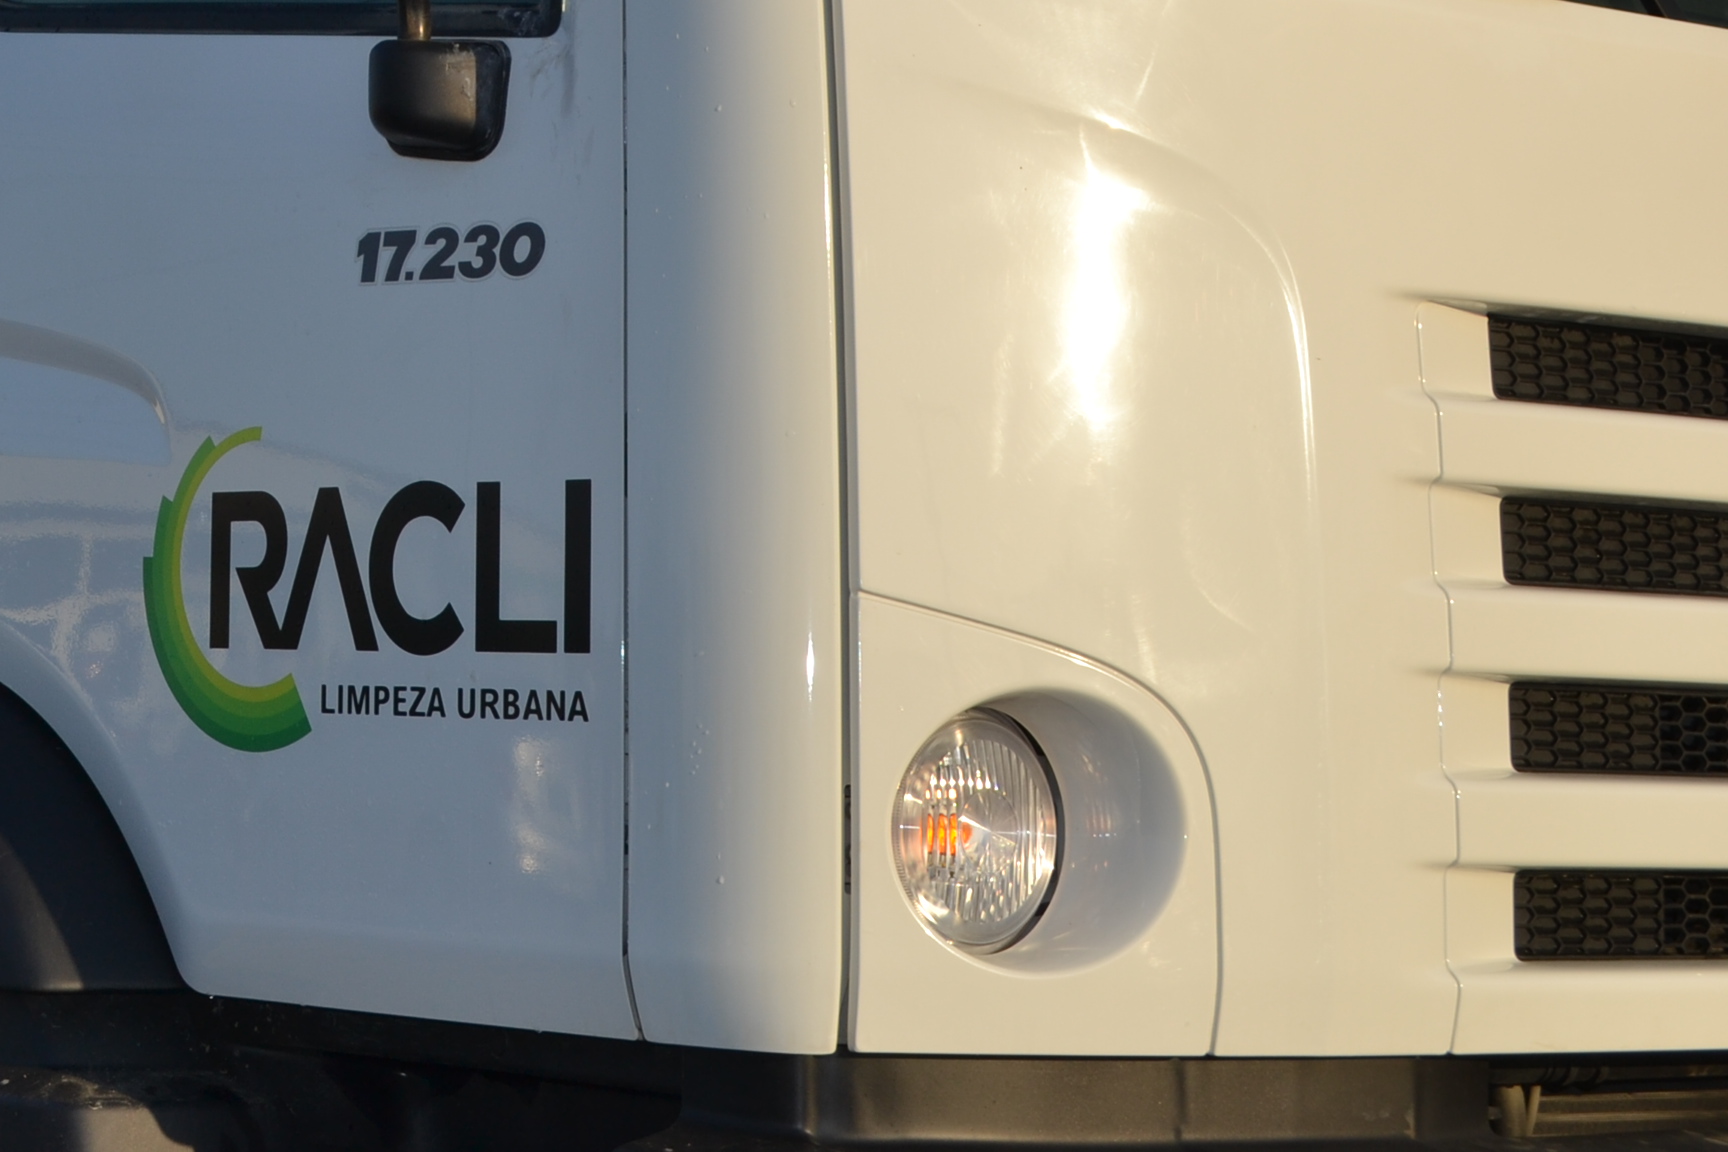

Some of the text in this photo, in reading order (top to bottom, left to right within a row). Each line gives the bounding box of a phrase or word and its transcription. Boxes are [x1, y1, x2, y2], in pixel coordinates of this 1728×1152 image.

[357, 221, 546, 283] 17.230
[209, 478, 592, 657] RACLI
[320, 684, 589, 722] LIMPEZA URBANA
